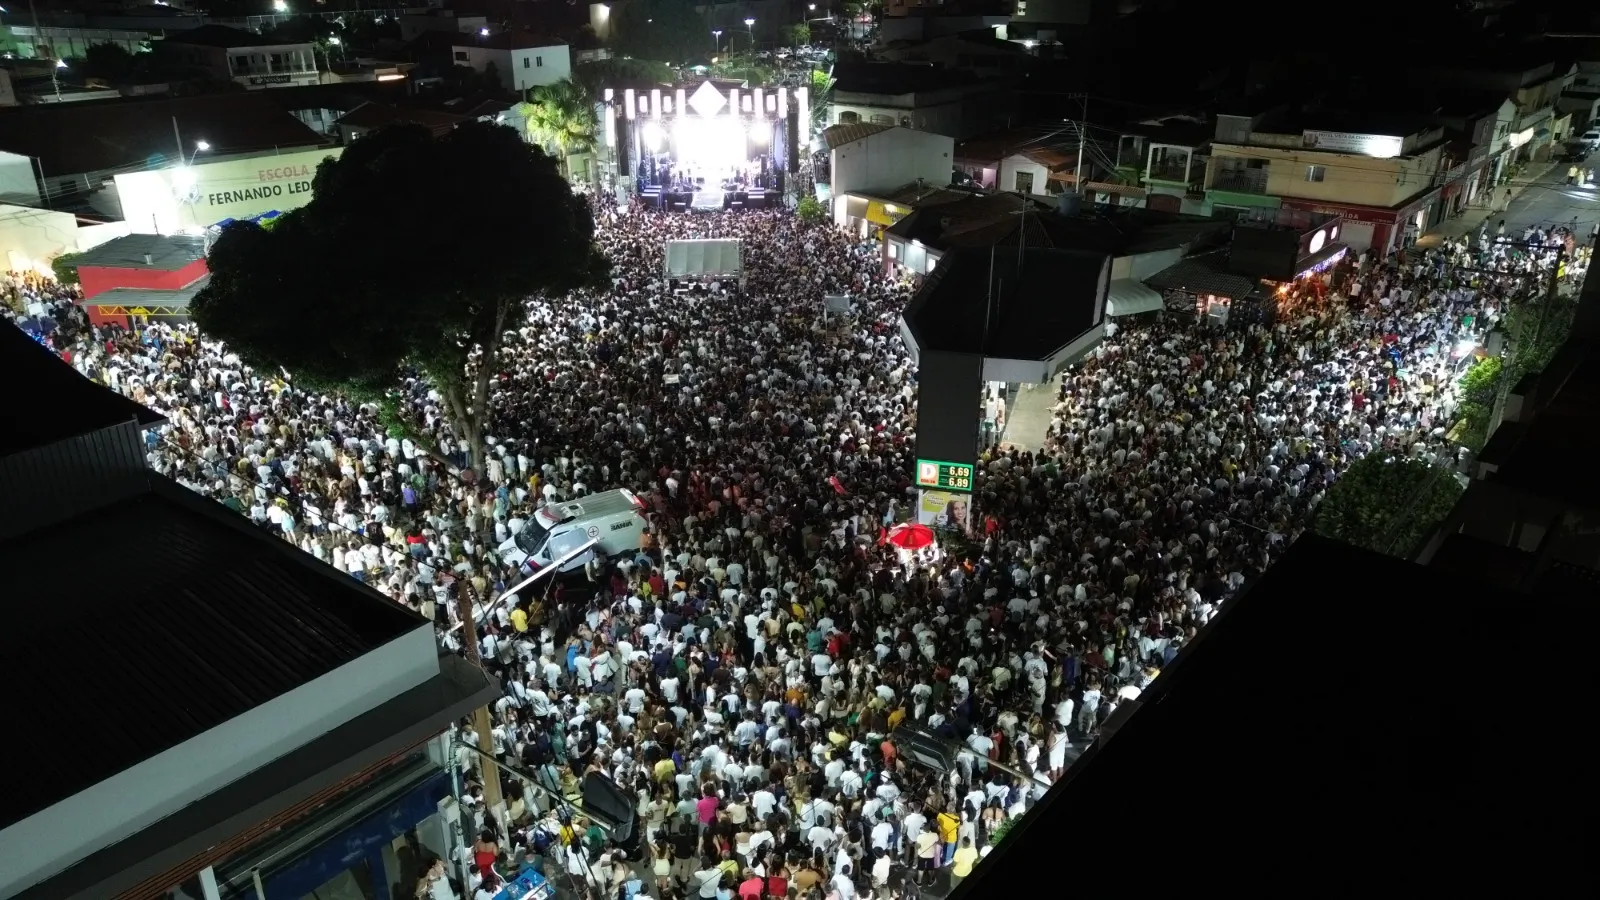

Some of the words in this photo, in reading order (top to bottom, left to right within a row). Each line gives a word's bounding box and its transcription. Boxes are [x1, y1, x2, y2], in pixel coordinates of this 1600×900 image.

[258, 165, 310, 181] ESCOLA
[208, 185, 282, 205] FERNANDO
[288, 181, 312, 195] LED
[949, 466, 970, 477] 6,69
[948, 477, 969, 488] 6,89
